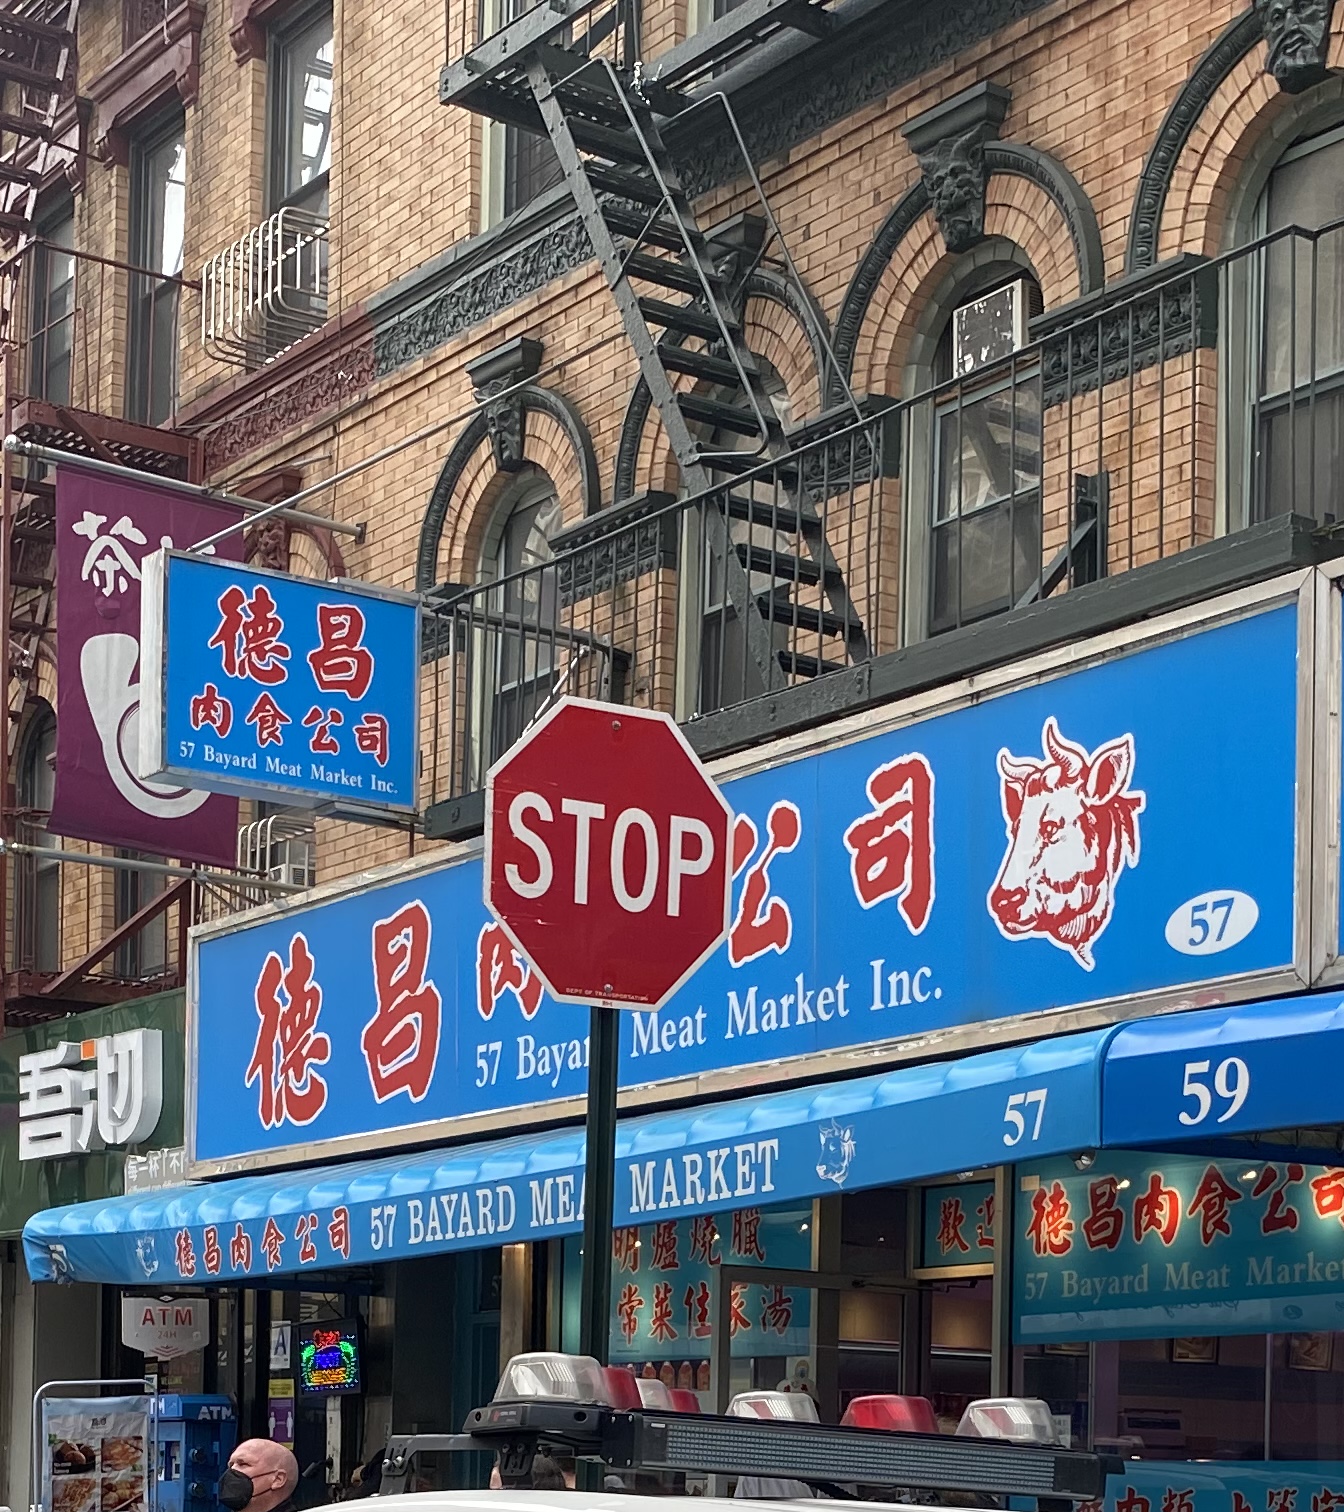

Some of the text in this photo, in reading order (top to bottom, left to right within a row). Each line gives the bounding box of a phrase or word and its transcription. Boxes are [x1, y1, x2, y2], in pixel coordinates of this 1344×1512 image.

[209, 585, 374, 700] 德昌
[190, 684, 390, 767] 肉食公司
[179, 740, 399, 795] 57 Bayard Meat Market Inc.
[505, 791, 715, 917] STOP
[1188, 898, 1234, 947] 57
[476, 959, 942, 1092] 57 Bayar Meat Market Inc.
[1002, 1057, 1250, 1147] 57 59
[371, 1139, 779, 1251] 57 BAYARD MEA MARKET
[174, 1205, 351, 1277] 德昌肉食公司
[142, 1307, 193, 1326] ATM
[1025, 1272, 1048, 1301] 57
[1061, 1262, 1150, 1305] Bayard
[1163, 1260, 1231, 1293] Meat
[273, 1327, 287, 1356] A
[198, 1405, 233, 1420] ATM
